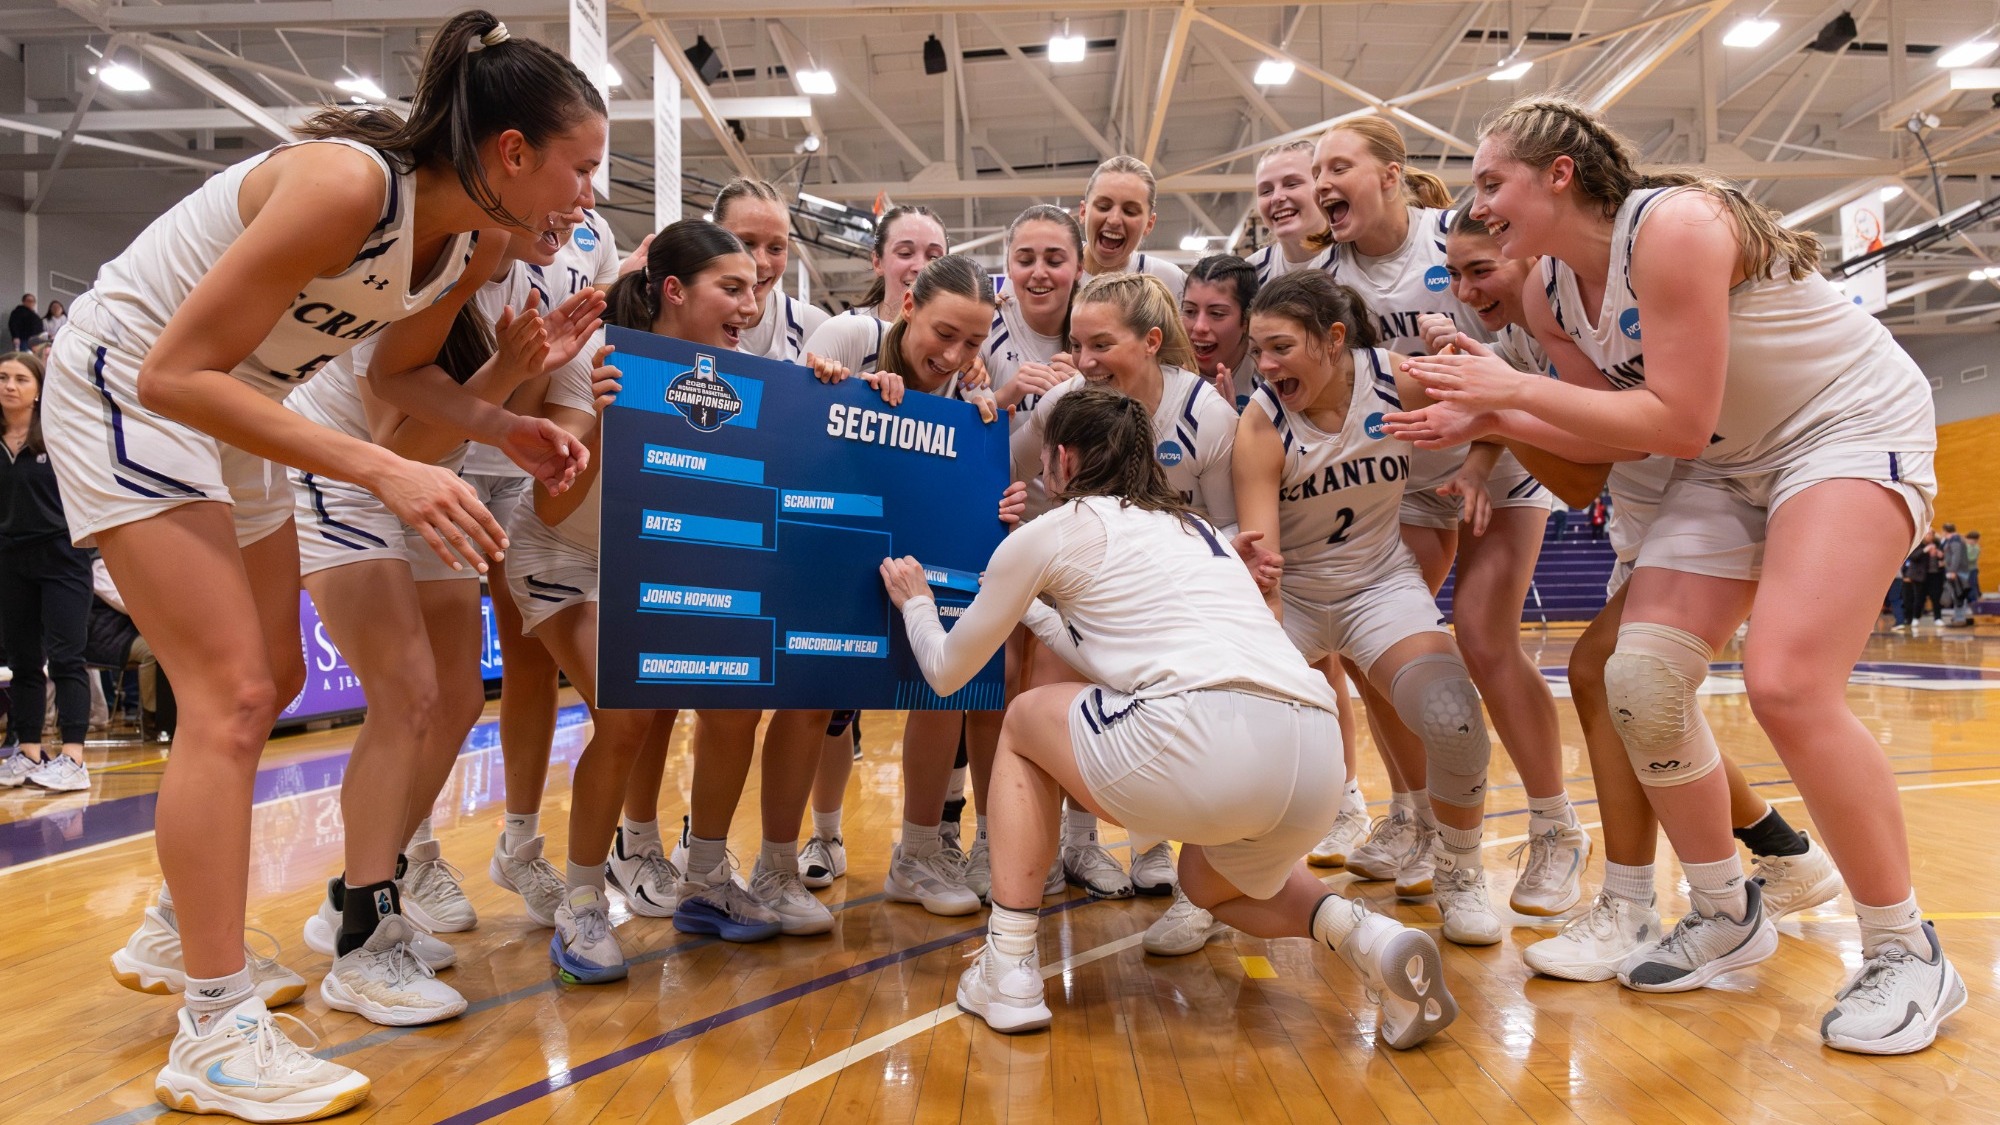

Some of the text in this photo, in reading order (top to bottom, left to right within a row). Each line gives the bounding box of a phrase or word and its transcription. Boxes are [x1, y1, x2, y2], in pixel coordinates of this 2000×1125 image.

[567, 266, 592, 294] TO
[1427, 276, 1449, 285] NCAA
[289, 292, 391, 339] CRA
[1380, 311, 1457, 341] ANT
[1626, 321, 1641, 336] NC
[668, 389, 740, 412] CHAMPIONSHIP
[827, 403, 957, 458] SECTIONAL
[1369, 422, 1391, 434] NC
[646, 449, 707, 471] SCRANTON
[1159, 452, 1181, 460] NCAA
[784, 494, 834, 510] SCRANTON
[645, 515, 682, 532] BATES
[1325, 507, 1354, 544] 2
[642, 589, 732, 609] JOHNS HOPKINS
[939, 605, 967, 617] CHAMP
[788, 636, 878, 654] CONCORDIA-M'HEAD
[642, 659, 749, 676] CONCORDIA-M'HEAD
